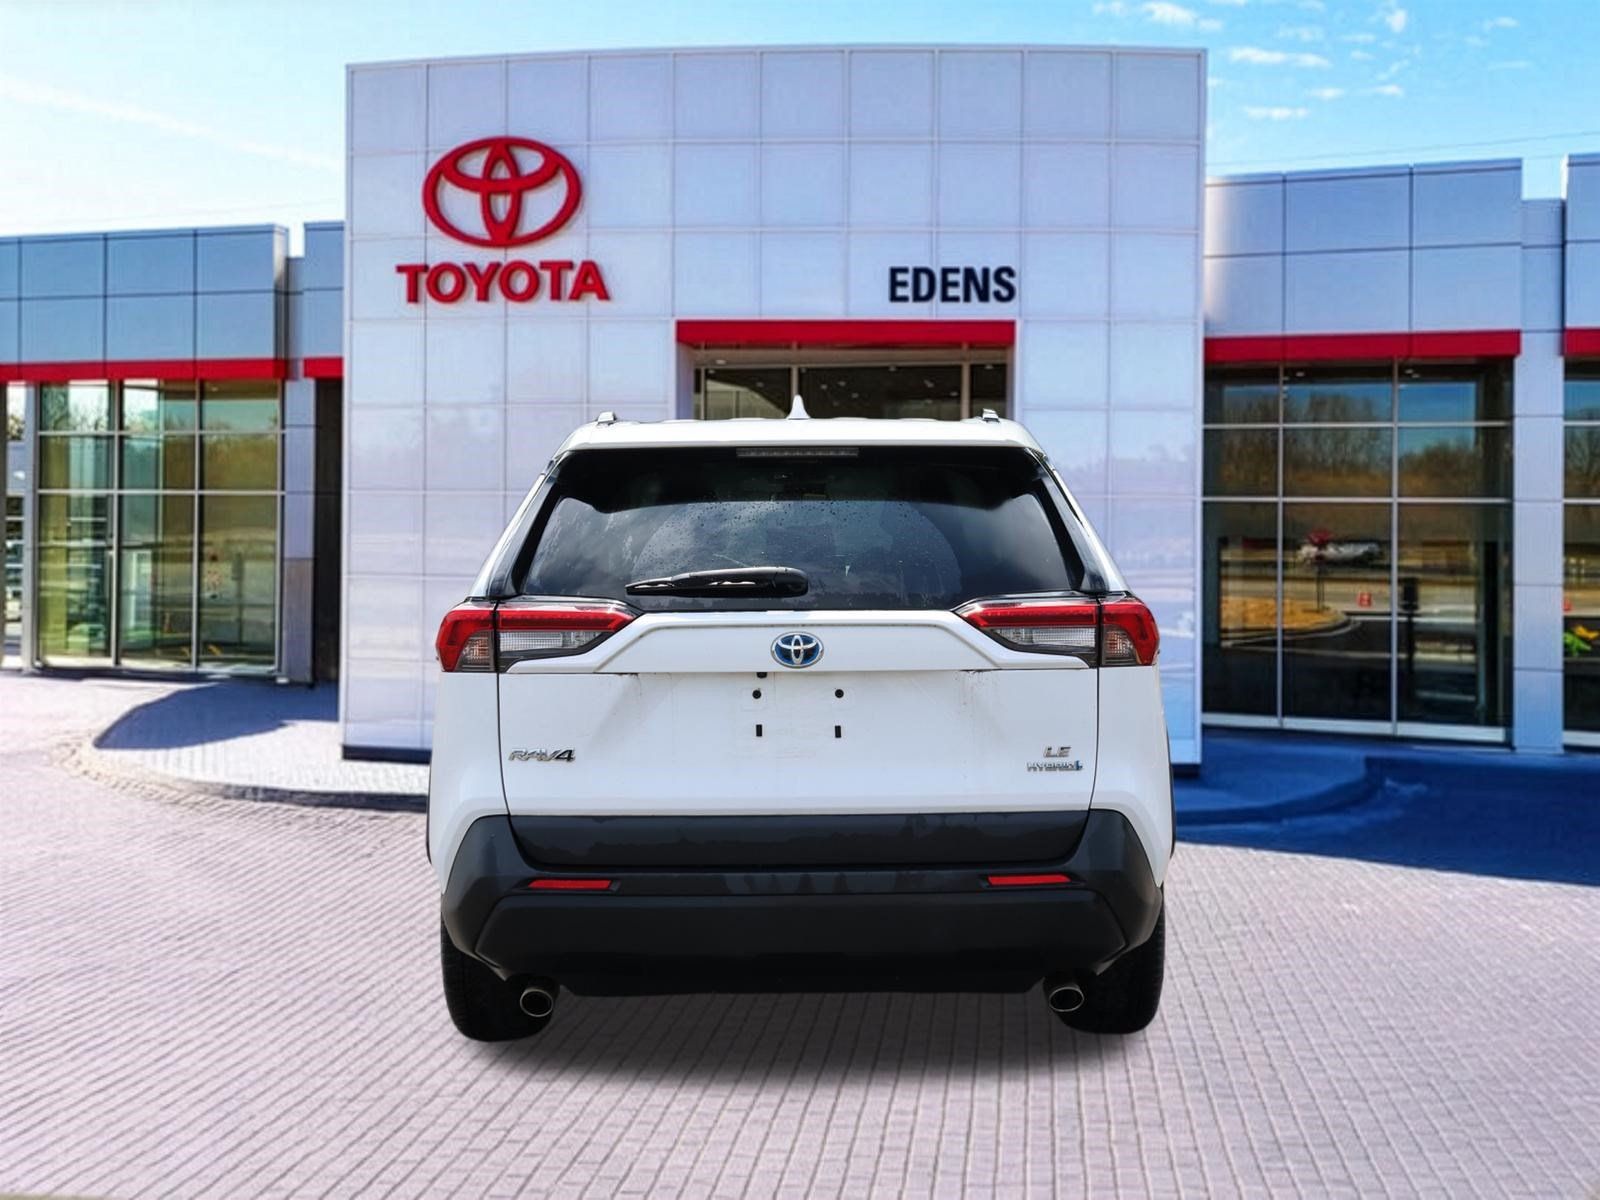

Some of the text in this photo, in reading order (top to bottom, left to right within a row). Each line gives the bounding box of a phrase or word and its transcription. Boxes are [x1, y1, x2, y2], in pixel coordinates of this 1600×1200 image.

[396, 260, 610, 303] TOYOTA
[889, 266, 1016, 303] EDENS
[508, 748, 575, 763] RAV4
[1043, 746, 1071, 758] LE
